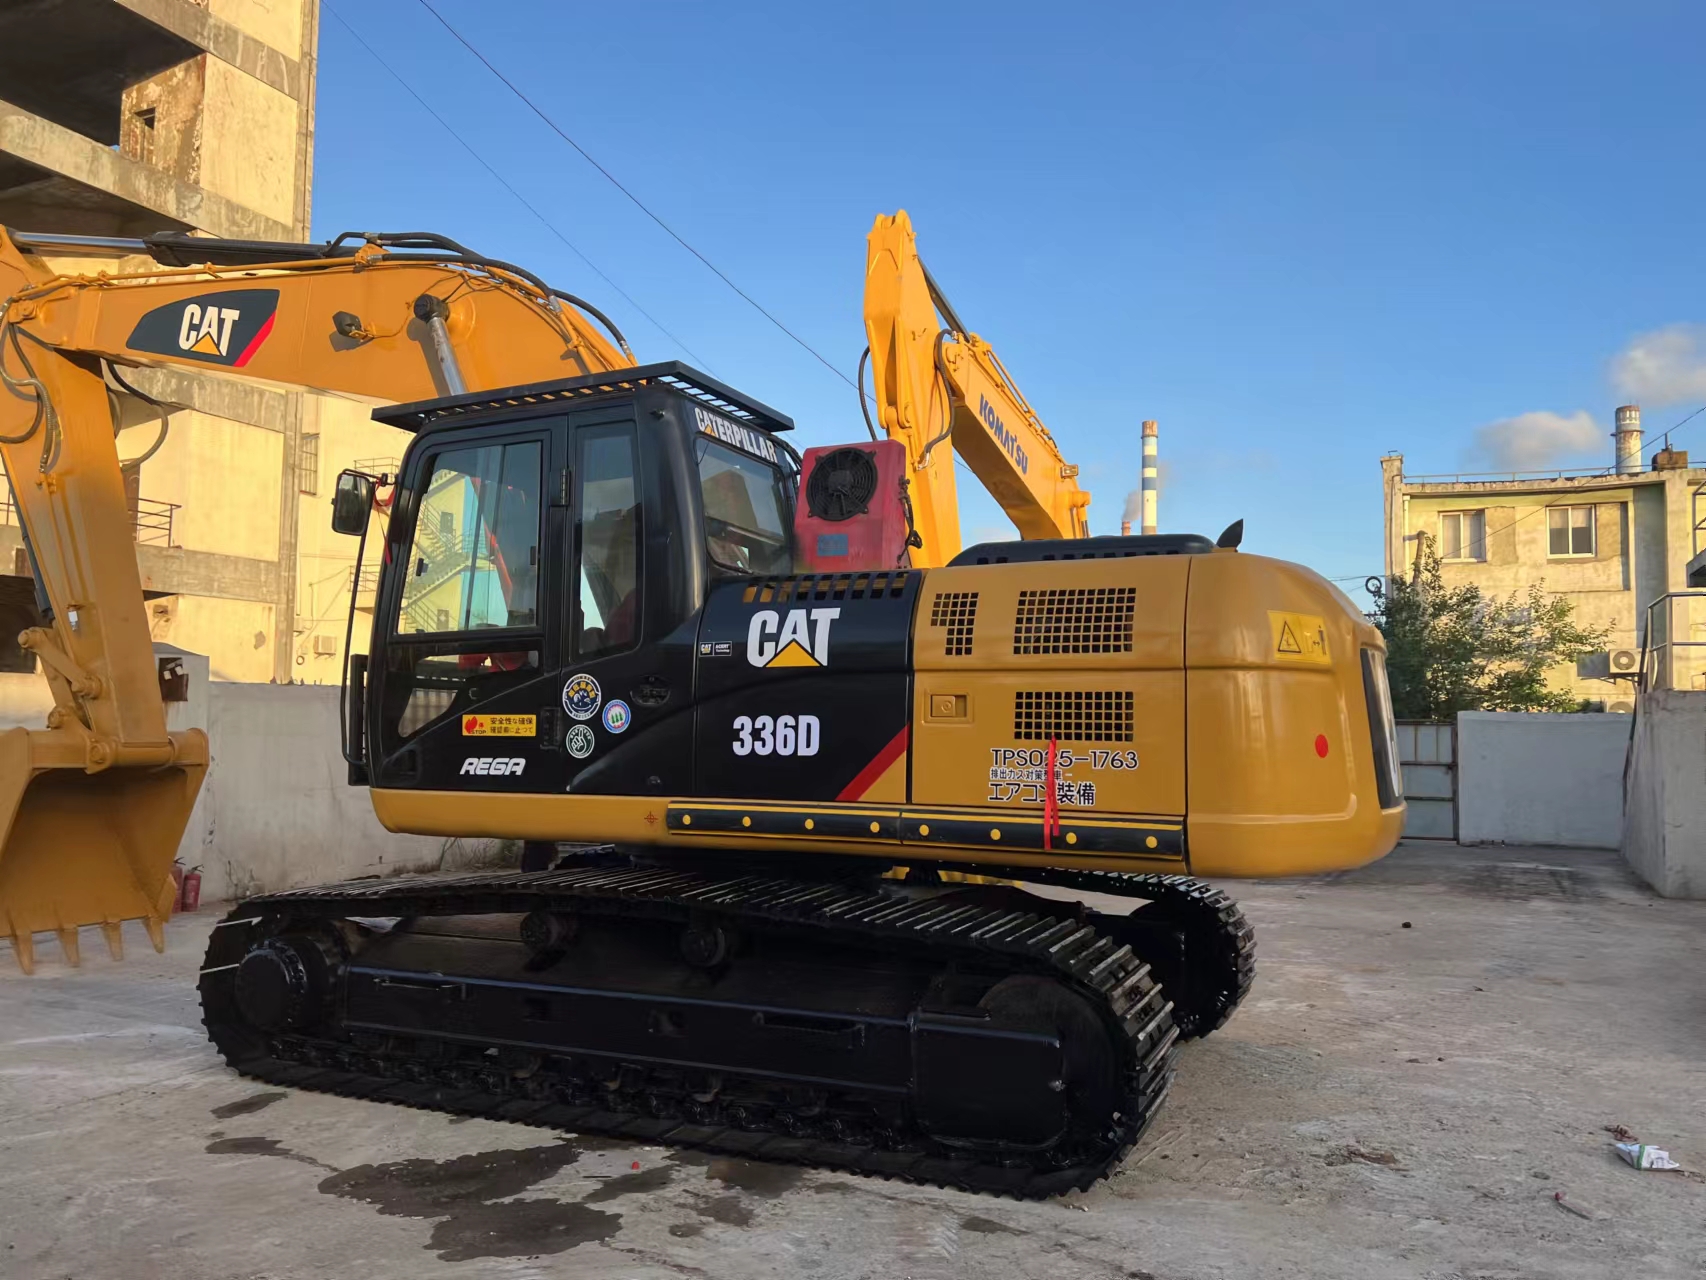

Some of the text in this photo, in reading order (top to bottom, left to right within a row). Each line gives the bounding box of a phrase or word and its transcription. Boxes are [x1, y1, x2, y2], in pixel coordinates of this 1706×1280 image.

[179, 303, 240, 356] CAT
[694, 407, 777, 464] CATERPILLAR
[979, 392, 1028, 475] KOMATSU
[746, 607, 841, 668] CAT
[732, 714, 820, 756] 336D
[460, 758, 526, 776] REGA
